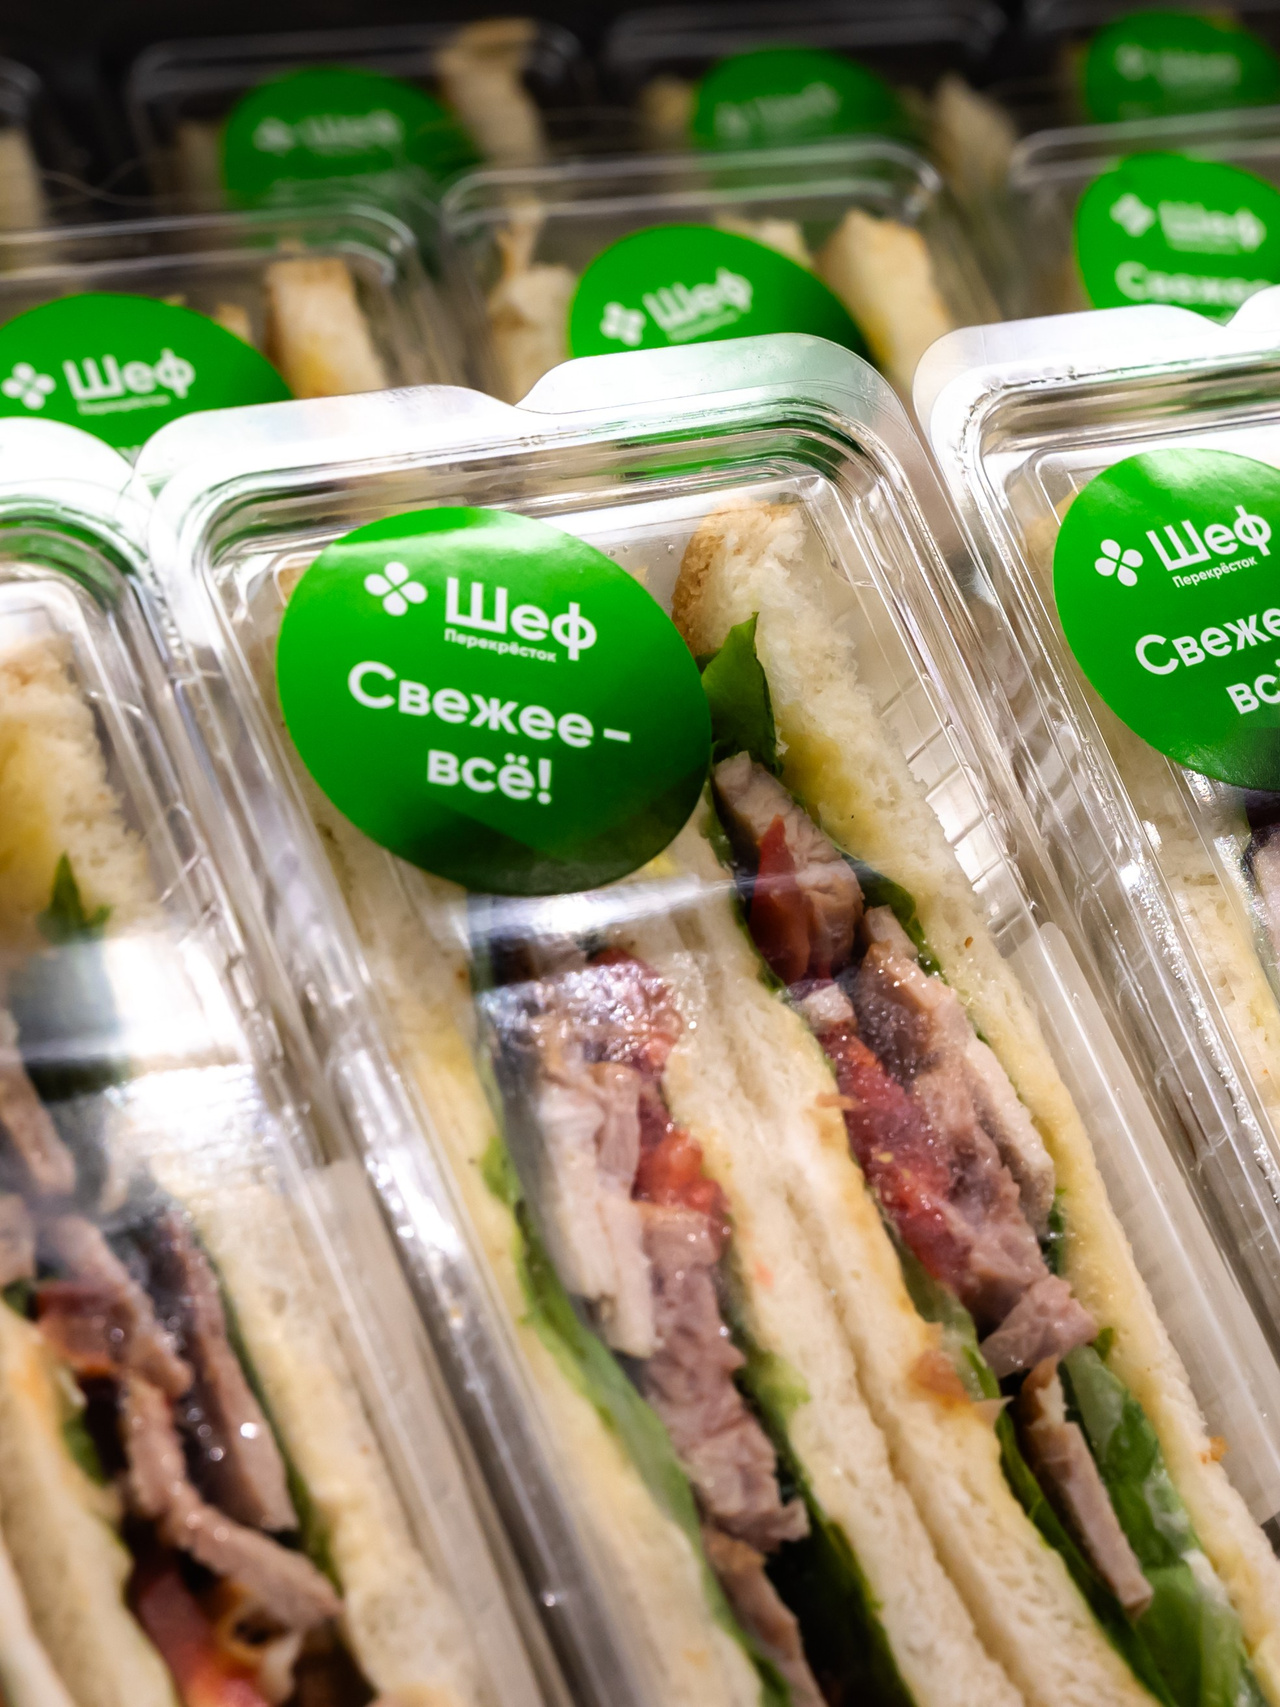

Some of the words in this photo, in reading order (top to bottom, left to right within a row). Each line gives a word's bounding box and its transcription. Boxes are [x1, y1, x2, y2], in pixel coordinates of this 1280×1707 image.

[642, 267, 753, 331] Шеф
[63, 350, 194, 401] Шеф
[1146, 505, 1271, 571] Шеф
[1172, 557, 1257, 587] Перекрёсток
[446, 571, 596, 660] Шеф
[445, 628, 556, 662] Перекрёсток
[428, 750, 551, 804] всё!
